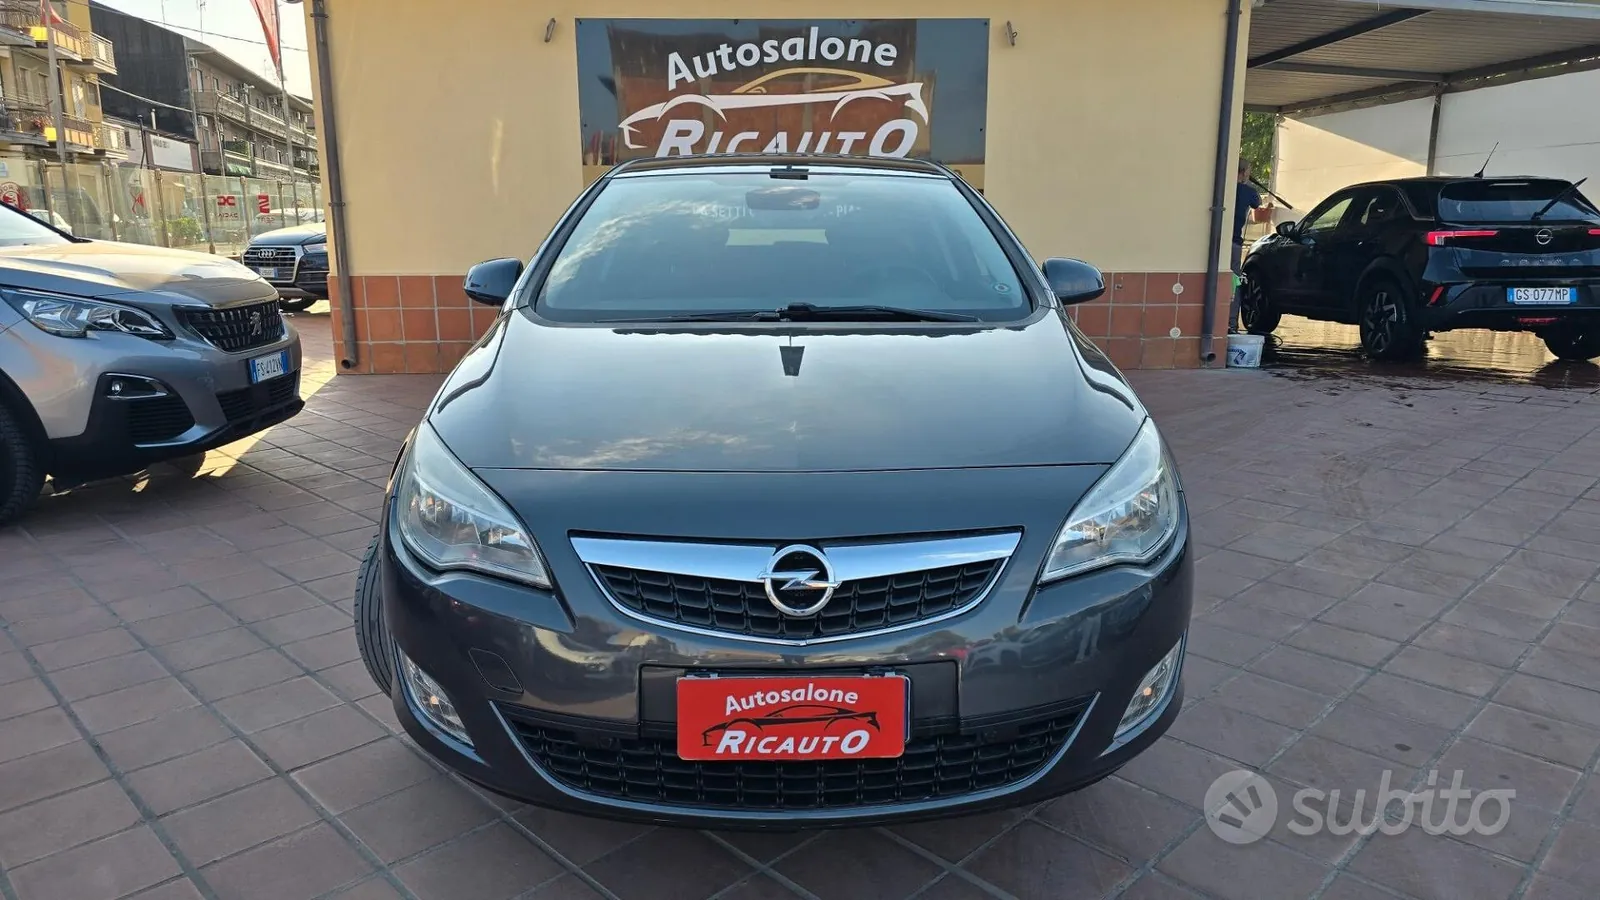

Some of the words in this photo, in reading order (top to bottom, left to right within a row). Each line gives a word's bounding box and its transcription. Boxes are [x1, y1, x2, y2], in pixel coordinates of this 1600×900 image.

[667, 27, 897, 90] Autosalone
[655, 119, 917, 158] RICAUTO
[1516, 289, 1530, 300] GS
[1533, 289, 1568, 300] 077MP
[725, 683, 858, 715] Autosalone
[715, 730, 870, 754] RICAUTO
